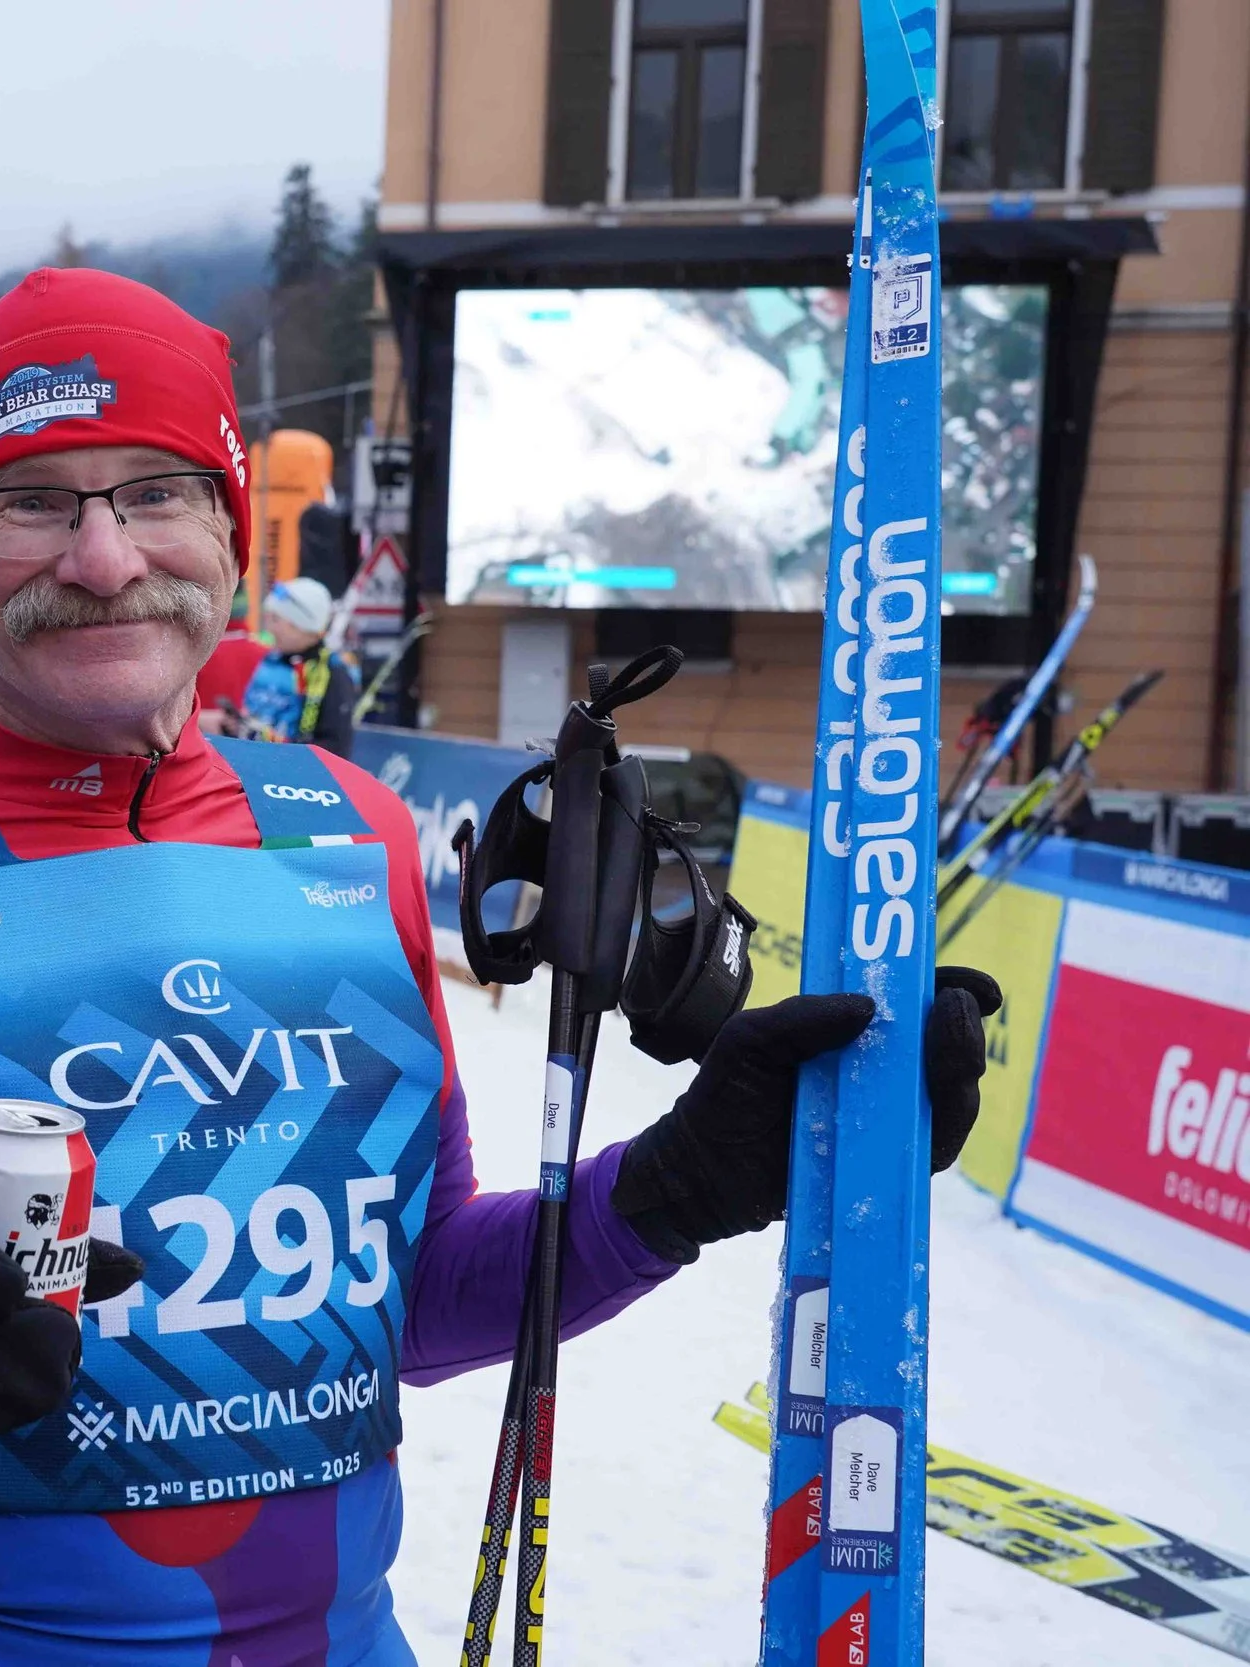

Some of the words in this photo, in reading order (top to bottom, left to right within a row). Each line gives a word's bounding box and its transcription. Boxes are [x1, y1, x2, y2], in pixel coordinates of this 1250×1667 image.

[10, 367, 39, 386] 2019
[38, 373, 84, 388] SYSTEM
[6, 388, 49, 412] BEAR
[52, 383, 111, 399] CHASE
[6, 403, 85, 427] MARATHON
[220, 413, 246, 488] TOKO
[851, 516, 927, 960] salomon
[263, 783, 341, 806] coop
[50, 1025, 353, 1110] CAVIT
[546, 1102, 559, 1129] Dave
[151, 1120, 300, 1153] TRENTO
[4, 1231, 89, 1277] ichnu
[25, 1278, 68, 1292] ANIMA
[810, 1322, 826, 1369] Melcher
[126, 1368, 379, 1443] MARCIALONGA
[790, 1402, 825, 1414] ERIENCES
[789, 1413, 825, 1434] UMI
[126, 1481, 183, 1507] 52ND
[189, 1467, 296, 1502] EDITION
[321, 1452, 361, 1482] 2025
[849, 1451, 863, 1502] Melcher
[867, 1462, 880, 1492] Dave
[831, 1536, 878, 1547] EXPERIENCES
[830, 1547, 877, 1570] LUMI
